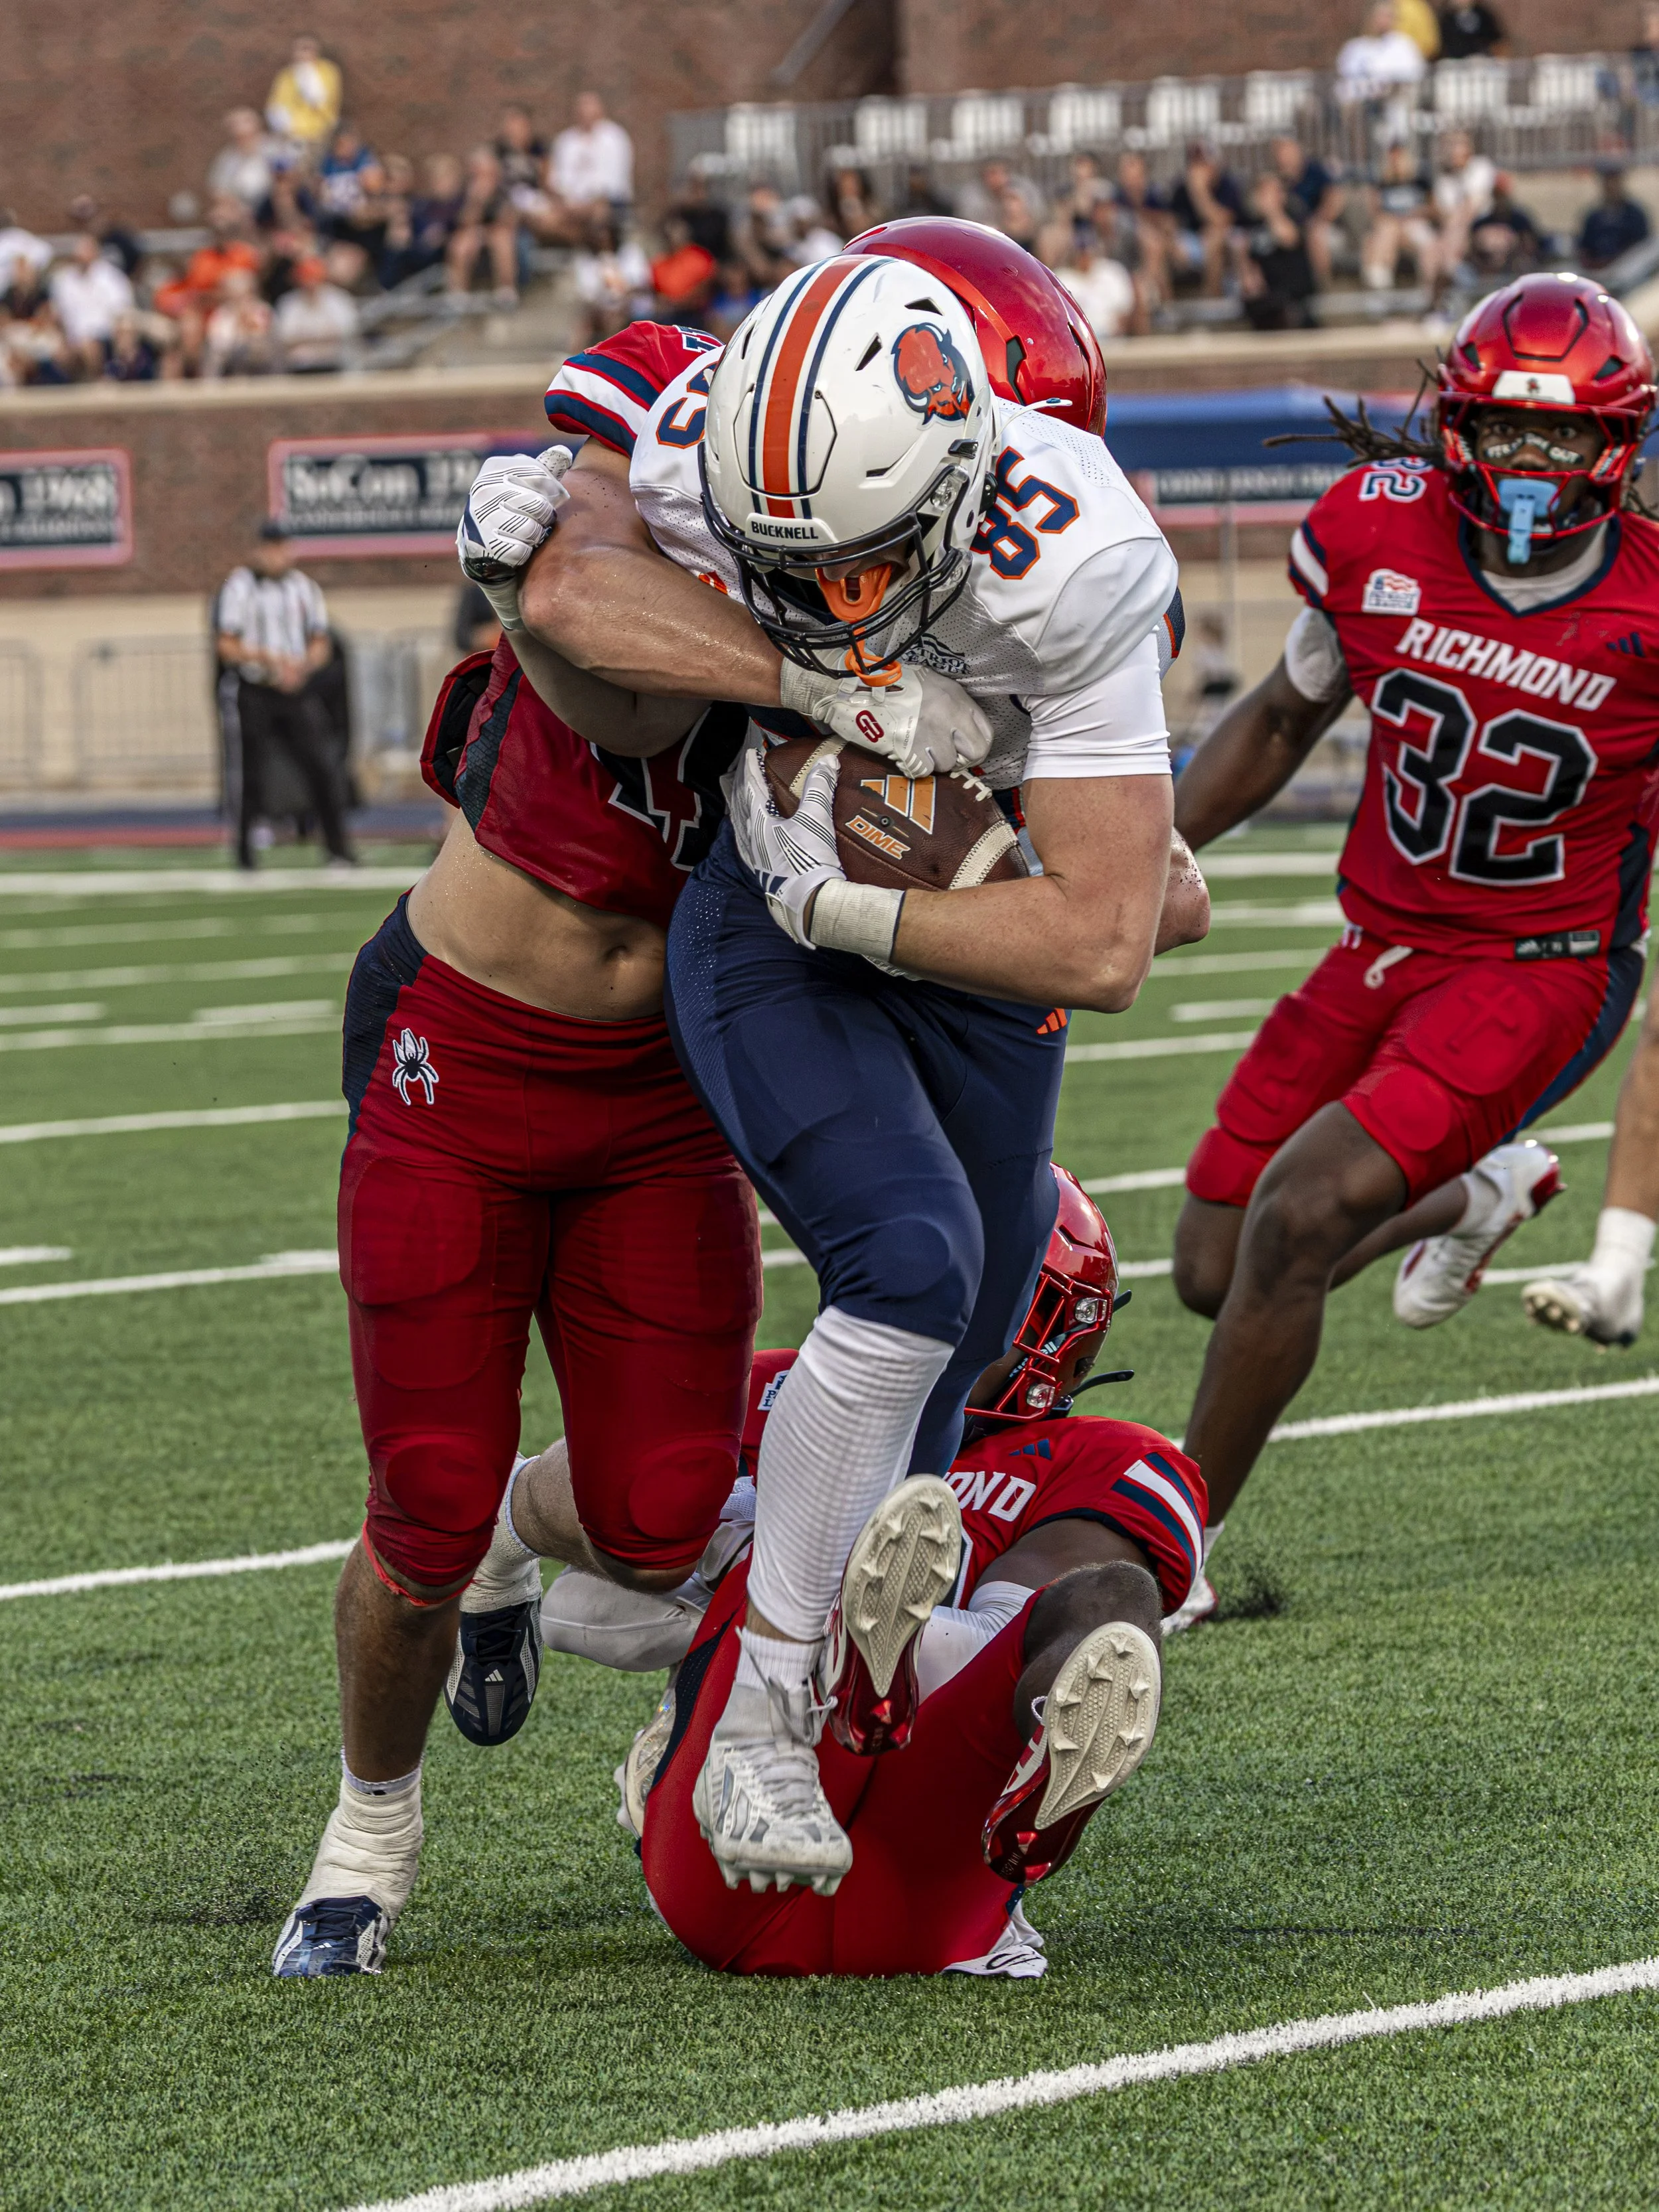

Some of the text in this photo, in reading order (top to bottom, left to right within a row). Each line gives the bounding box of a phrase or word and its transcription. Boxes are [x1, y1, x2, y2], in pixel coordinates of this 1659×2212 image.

[751, 520, 818, 539] BUCKNELL
[970, 446, 1080, 580] 85
[1396, 617, 1617, 711] RICHMOND
[1371, 668, 1598, 885] 32
[845, 815, 911, 860] DIME
